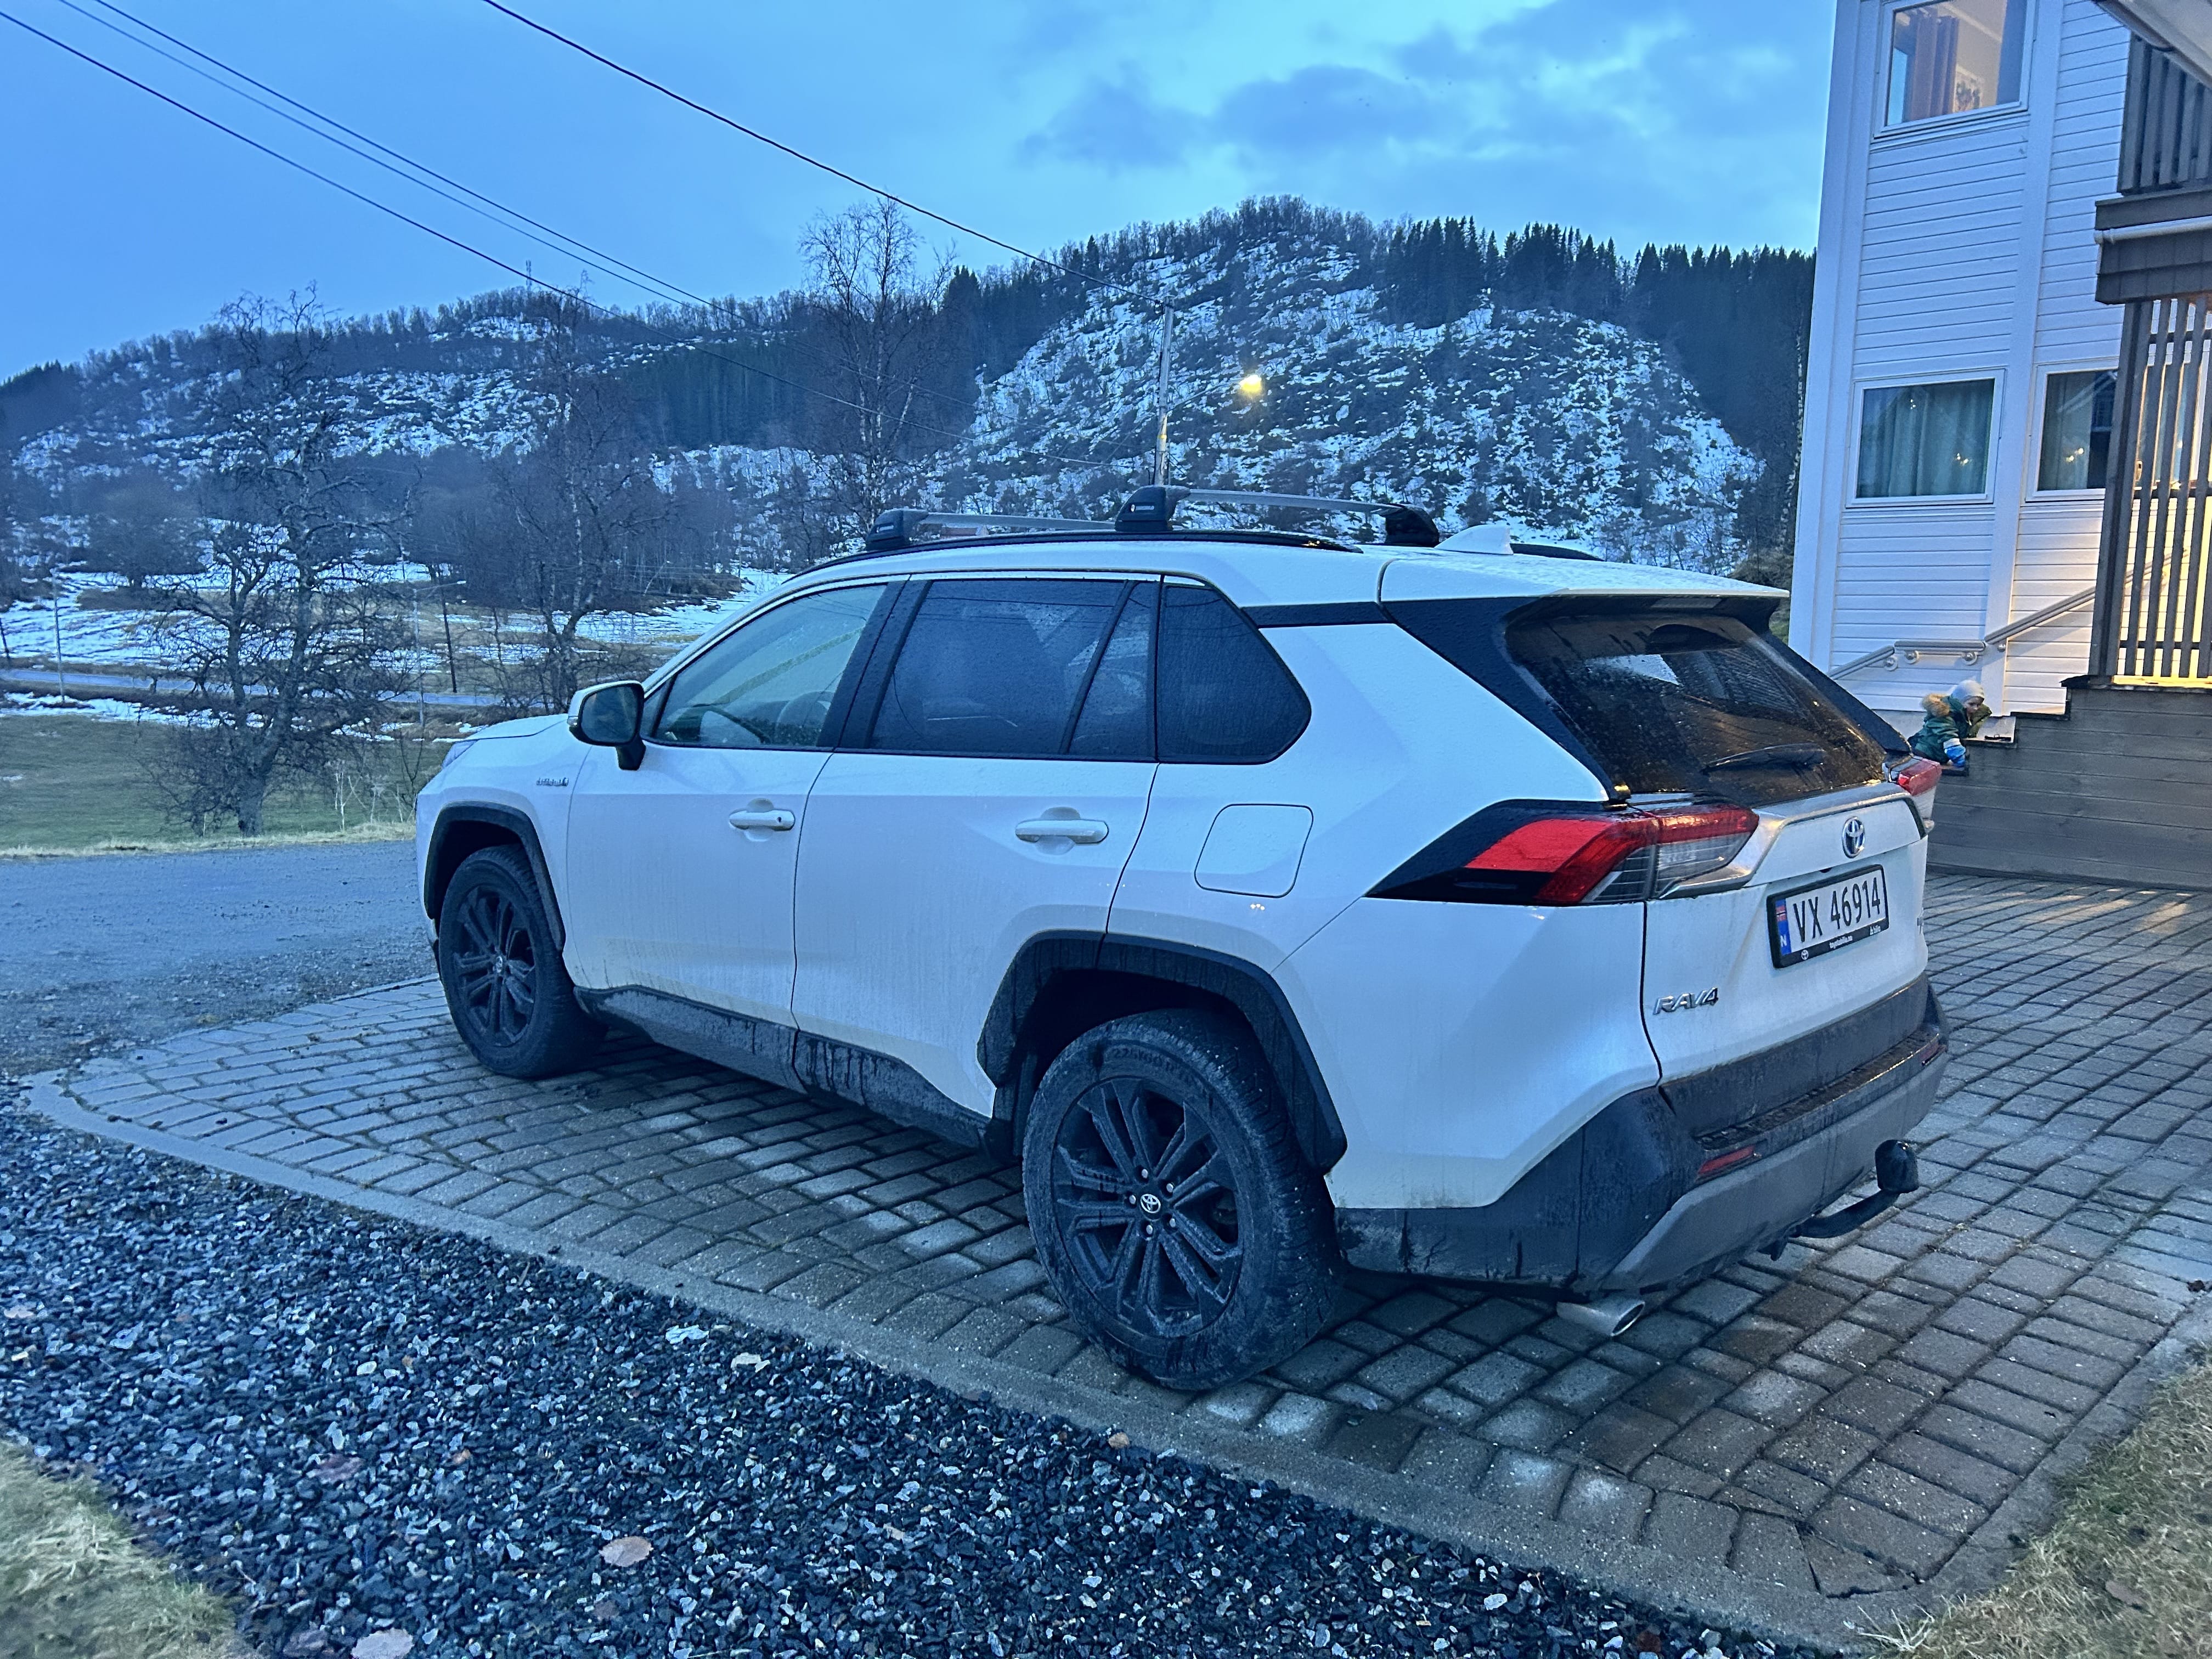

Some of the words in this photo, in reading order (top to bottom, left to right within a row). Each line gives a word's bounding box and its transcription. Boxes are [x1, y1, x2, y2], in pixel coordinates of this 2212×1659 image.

[1793, 896, 1822, 942] VX
[1831, 877, 1880, 929] 46914
[1780, 935, 1787, 947] N
[1652, 987, 1719, 1015] RAV4
